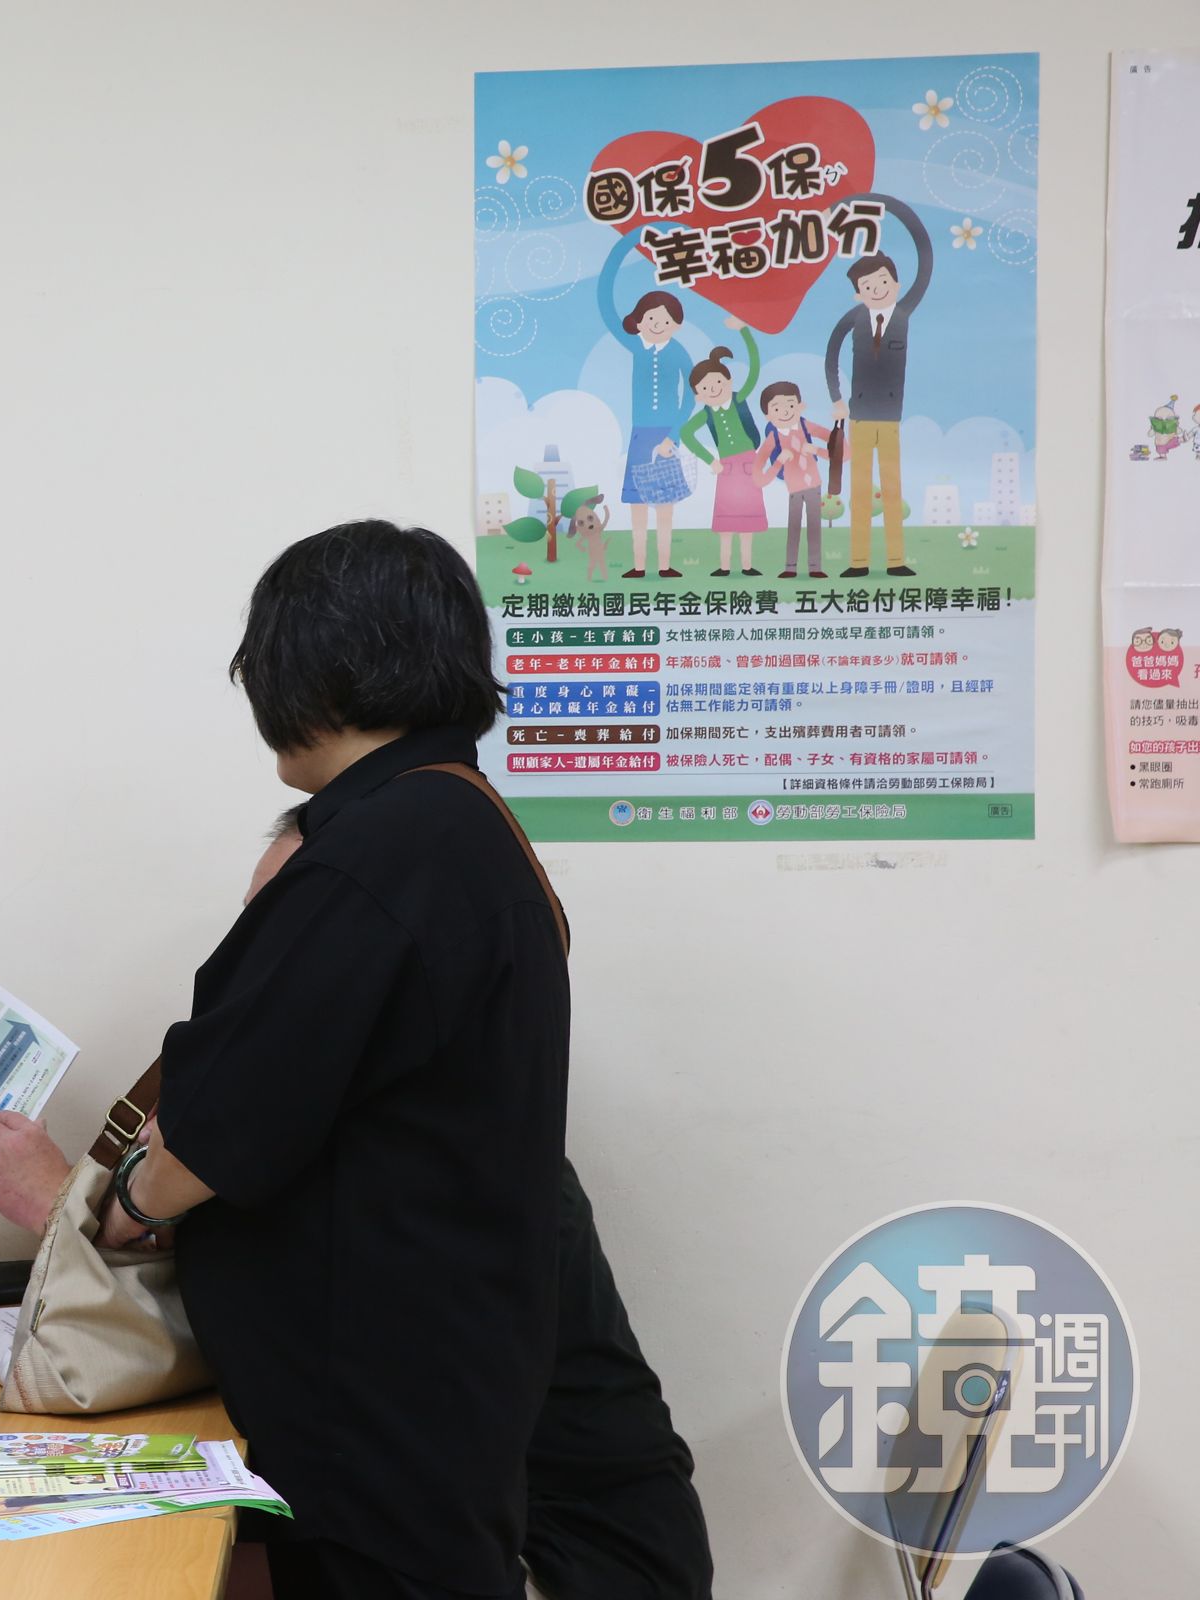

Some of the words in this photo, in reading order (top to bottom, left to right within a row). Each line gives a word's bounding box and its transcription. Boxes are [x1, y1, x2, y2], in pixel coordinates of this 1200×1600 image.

[643, 203, 885, 286] 幸福加分
[502, 590, 779, 618] 定期繳納國民年金保險費
[665, 625, 945, 642] 女性被保險人加保期間分娩或早產都可請領。
[1132, 655, 1179, 668] 爸爸媽媽
[1137, 669, 1172, 681] 看過來
[512, 700, 655, 715] 身心障礙年金給付
[666, 698, 802, 713] 估無工作能力可請領。
[666, 724, 917, 740] 加保期間死亡，支出殯葬費用者可請領。
[1139, 762, 1173, 773] 黑眼圈
[637, 806, 738, 820] 衛生福利部
[776, 804, 907, 820] 勞動部勞工保險局
